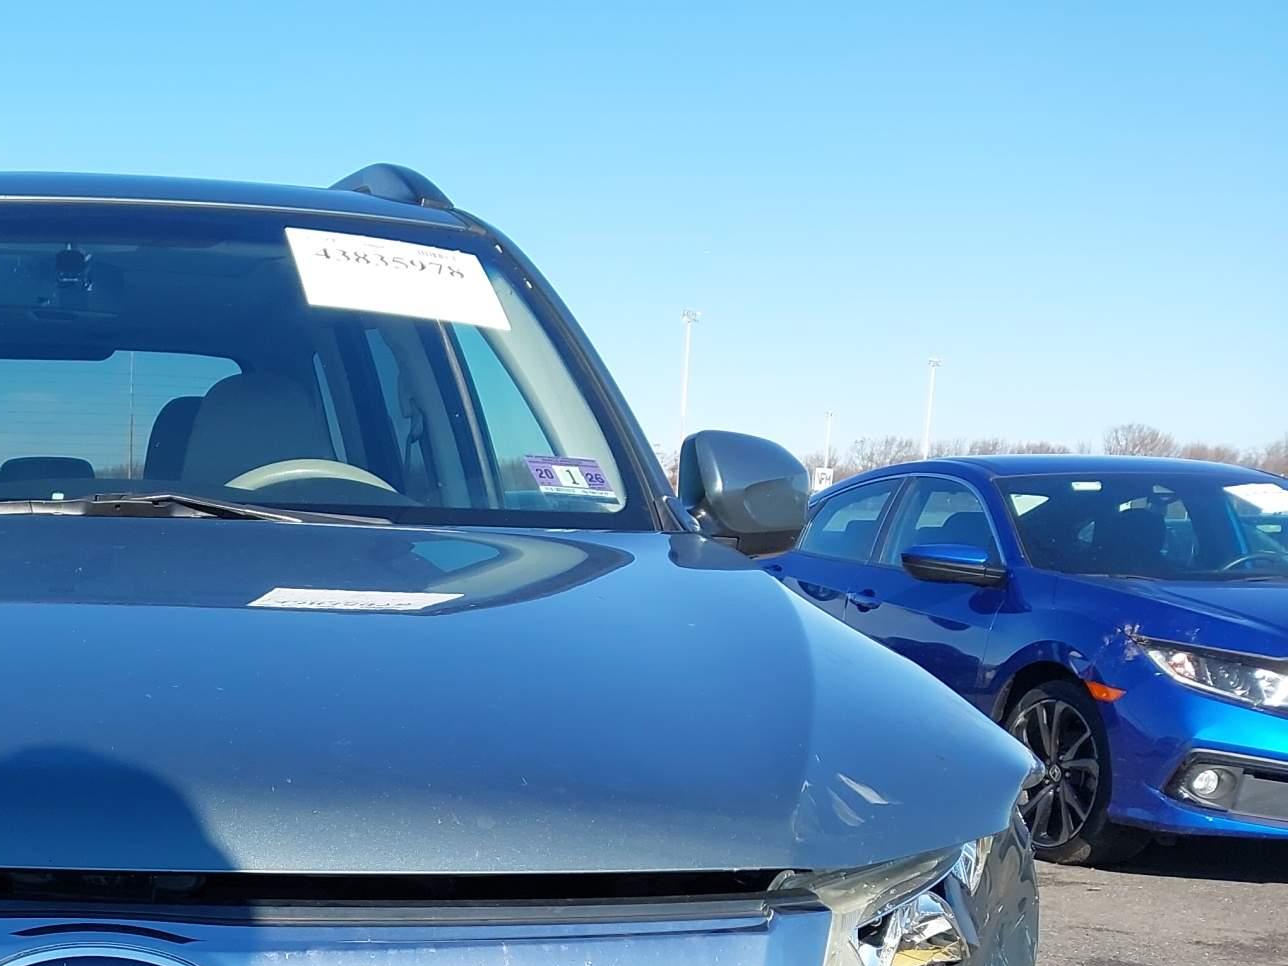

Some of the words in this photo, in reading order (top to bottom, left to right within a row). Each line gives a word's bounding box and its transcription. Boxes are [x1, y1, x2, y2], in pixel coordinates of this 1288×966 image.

[535, 468, 555, 480] 20
[565, 469, 580, 486] 1
[585, 472, 605, 484] 26
